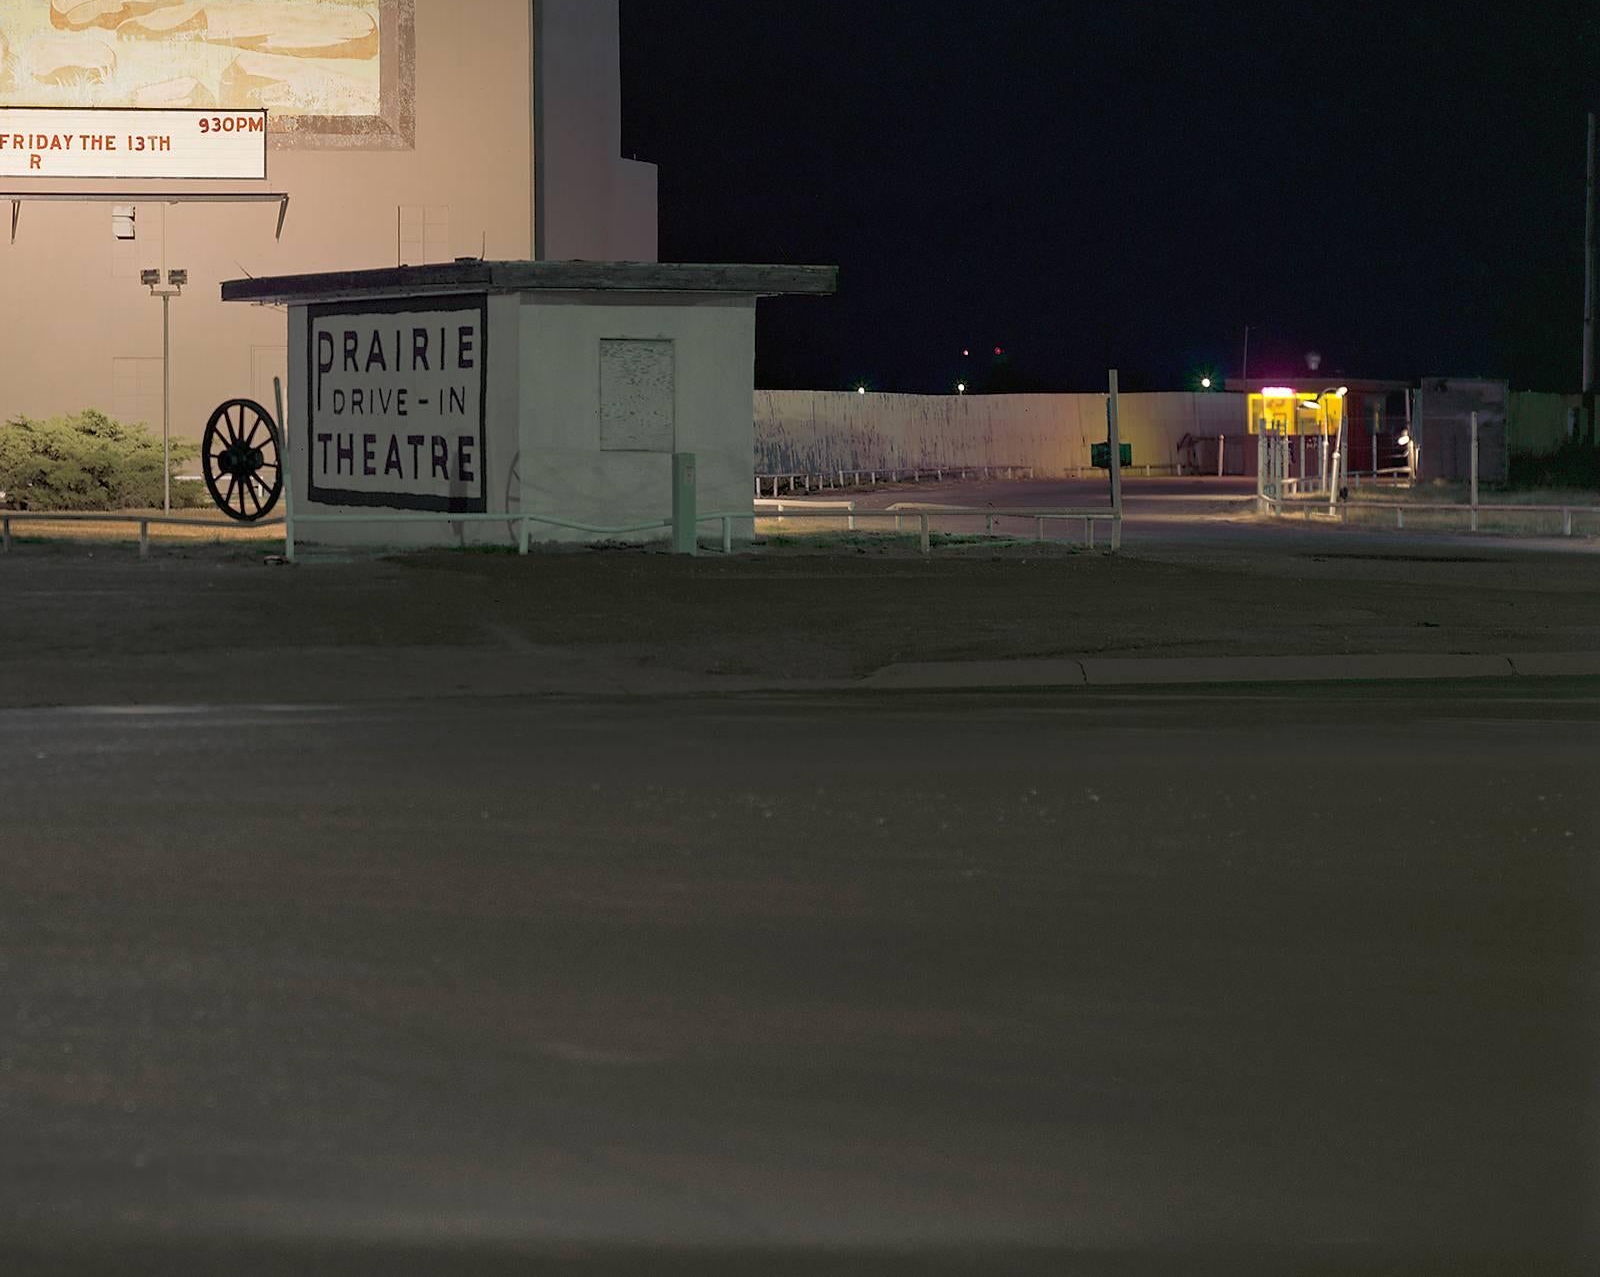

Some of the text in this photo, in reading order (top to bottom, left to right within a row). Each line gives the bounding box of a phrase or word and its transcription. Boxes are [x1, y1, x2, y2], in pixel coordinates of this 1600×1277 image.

[199, 116, 264, 132] 930PM
[79, 134, 117, 151] THE
[128, 135, 171, 151] 13TH
[30, 154, 42, 169] R
[317, 325, 475, 411] PRAIRIE
[332, 386, 467, 416] DRIVE-IN
[317, 433, 475, 483] THEATRE
